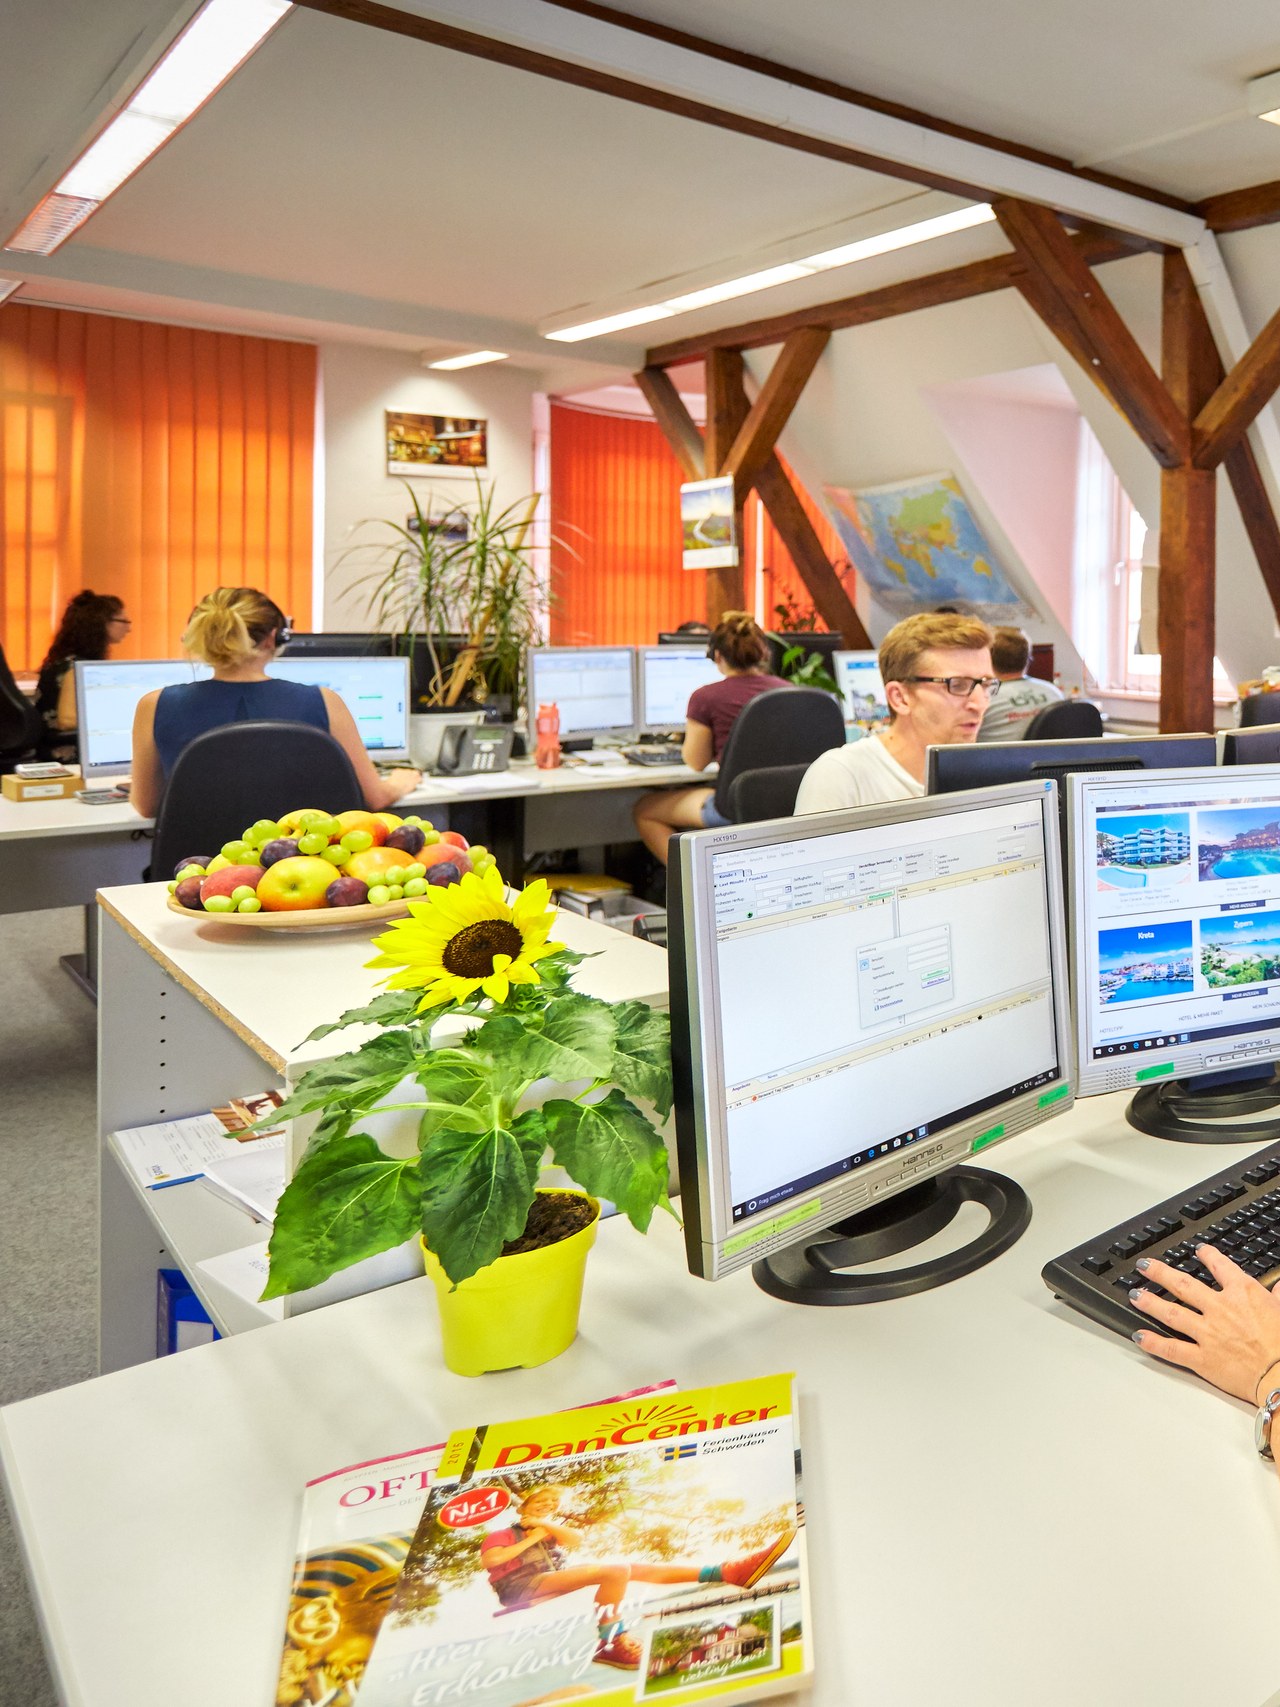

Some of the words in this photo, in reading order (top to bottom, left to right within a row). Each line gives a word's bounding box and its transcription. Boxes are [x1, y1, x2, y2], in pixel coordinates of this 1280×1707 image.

[713, 833, 738, 843] HX191D
[1138, 932, 1155, 940] Kreta
[493, 1405, 778, 1469] DanCenter
[702, 1438, 765, 1455] Schweden
[703, 1427, 780, 1448] Ferienhäuser
[339, 1467, 440, 1508] OFT
